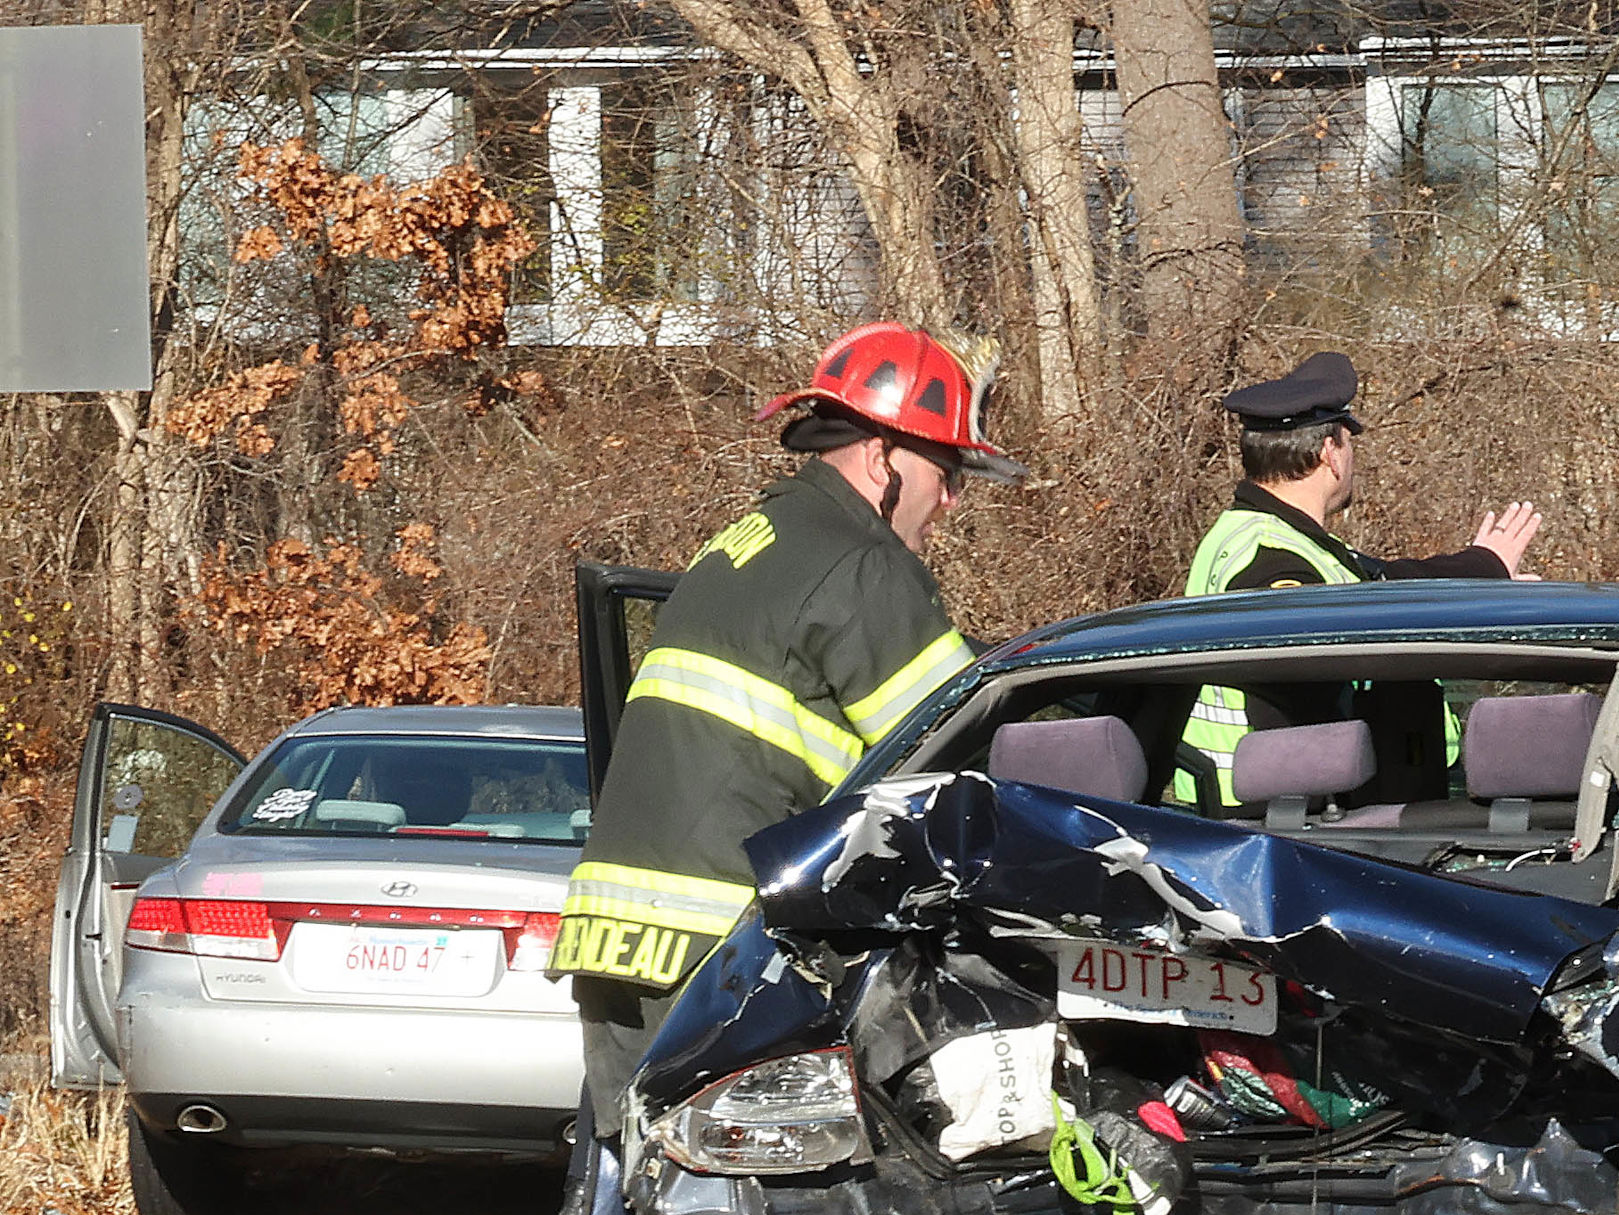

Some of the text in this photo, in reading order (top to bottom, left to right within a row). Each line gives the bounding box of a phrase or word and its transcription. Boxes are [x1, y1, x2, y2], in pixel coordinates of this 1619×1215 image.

[346, 944, 446, 974] 6NAD 47
[1071, 948, 1268, 1006] 4DTP 13
